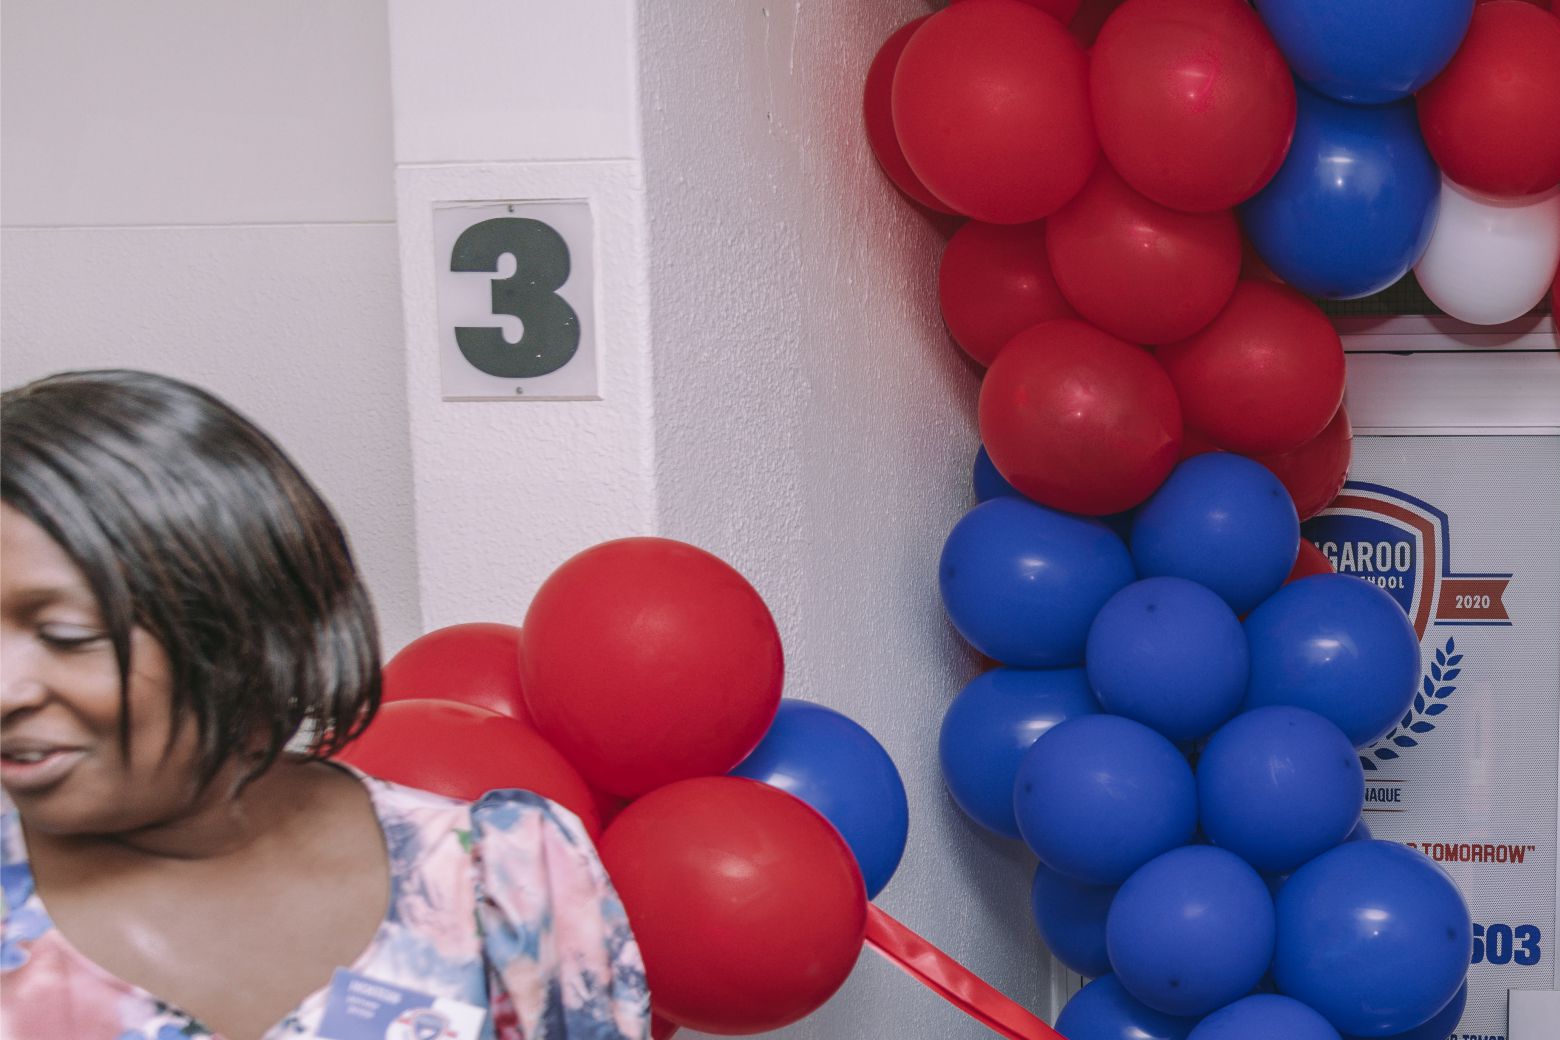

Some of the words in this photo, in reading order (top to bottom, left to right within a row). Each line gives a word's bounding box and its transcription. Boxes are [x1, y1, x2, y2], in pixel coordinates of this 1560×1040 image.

[450, 216, 581, 379] 3
[1315, 541, 1411, 574] GAROO
[1455, 595, 1491, 609] 2020
